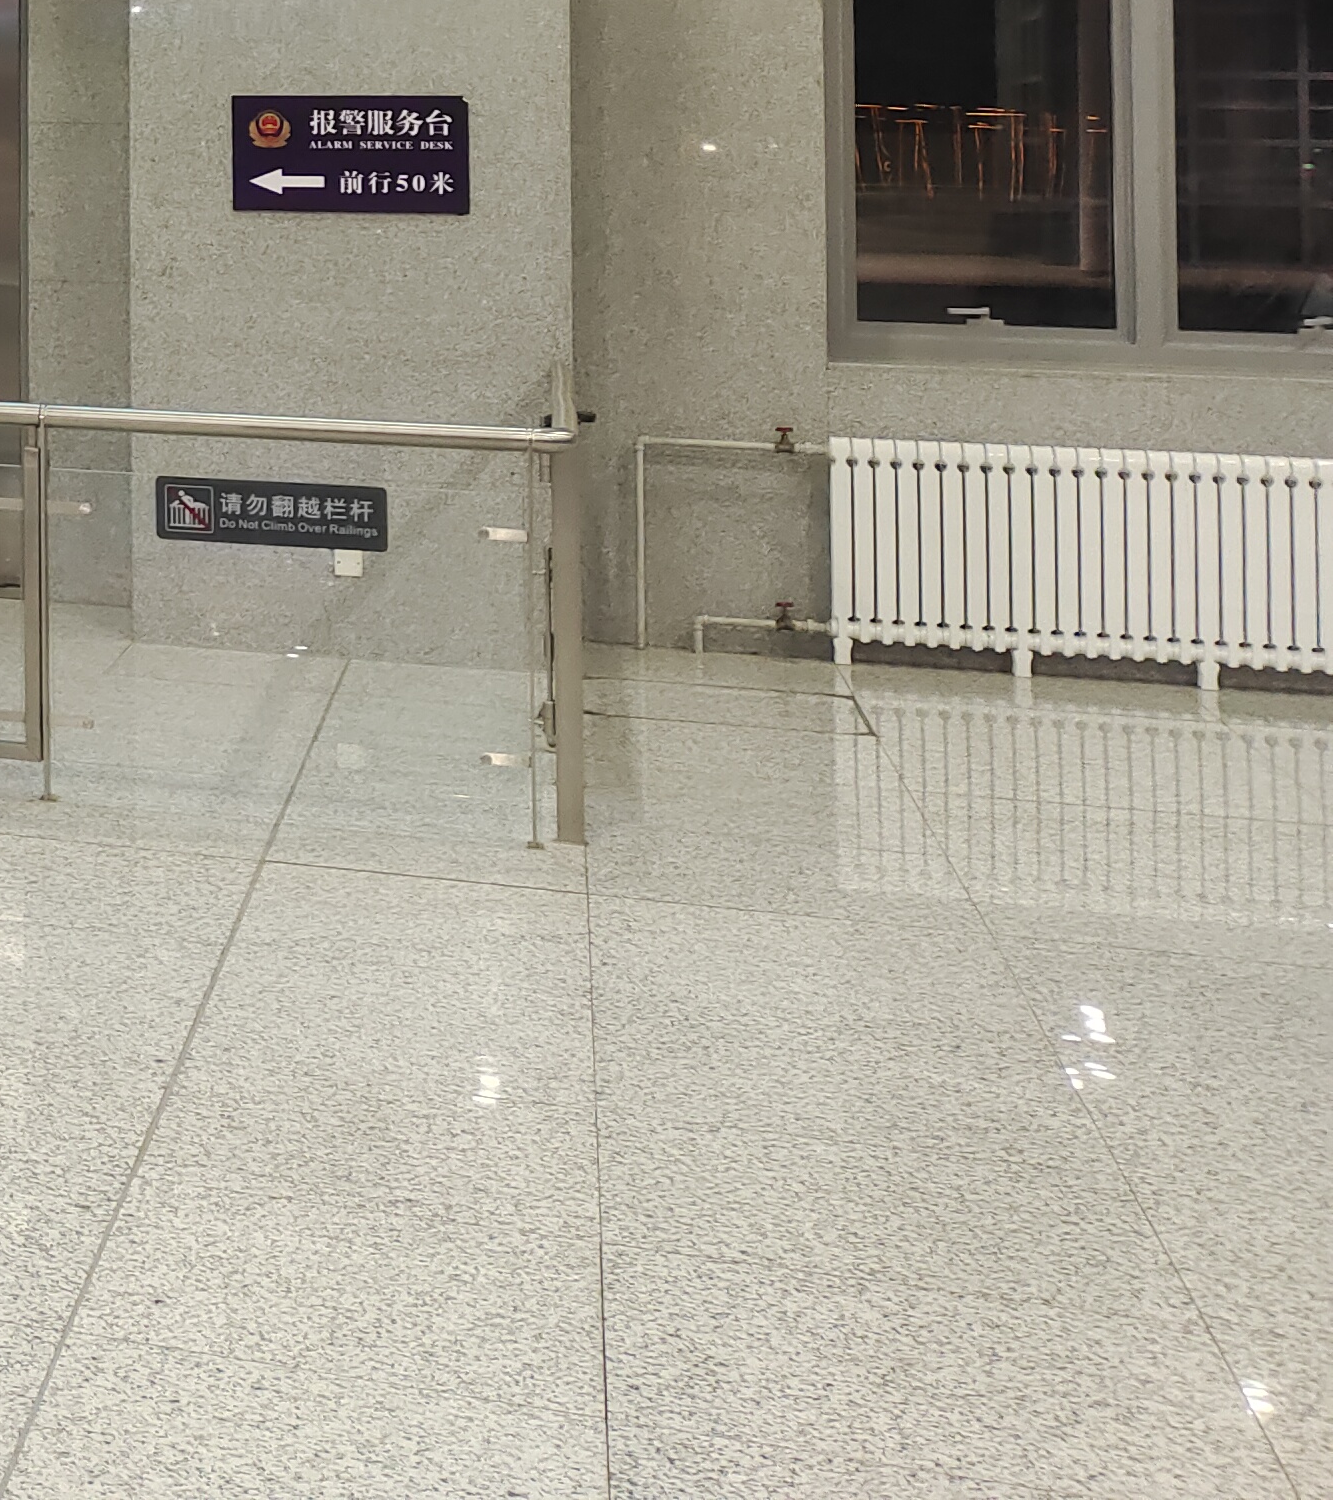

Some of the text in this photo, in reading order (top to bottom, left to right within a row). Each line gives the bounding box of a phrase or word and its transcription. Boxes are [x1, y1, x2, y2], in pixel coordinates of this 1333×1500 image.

[309, 109, 453, 136] 报警服务台
[309, 140, 453, 150] ALARM SERVICE DESK
[339, 171, 455, 195] 前行50米
[219, 492, 374, 523] 请勿翻越栏杆
[219, 517, 379, 539] Do Not Climb Over Railings
